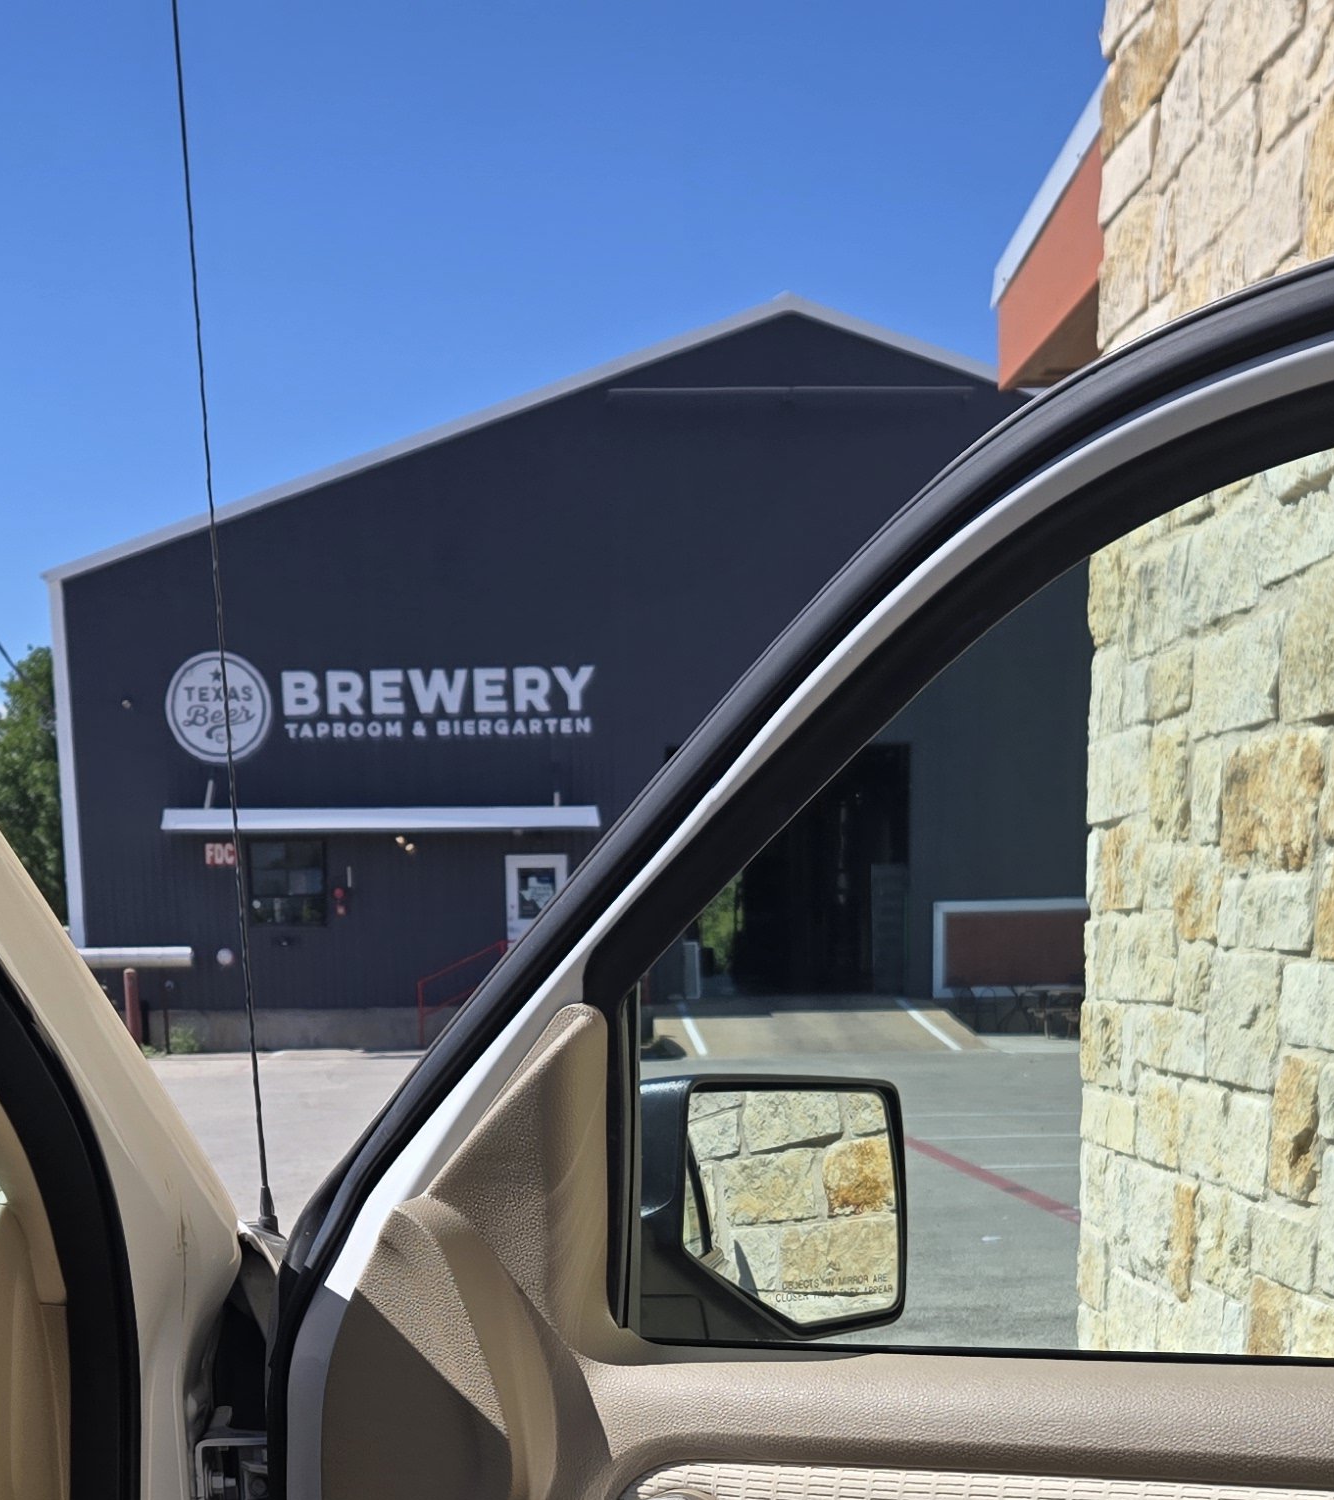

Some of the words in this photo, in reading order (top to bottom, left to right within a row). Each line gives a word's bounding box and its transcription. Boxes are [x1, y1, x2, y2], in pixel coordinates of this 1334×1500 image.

[183, 686, 253, 702] TEXAS
[281, 664, 595, 716] BREWERY
[182, 704, 256, 728] Beer
[284, 720, 403, 739] TAPROOM
[412, 719, 427, 737] &
[436, 716, 592, 737] BIERGARTEN
[204, 843, 235, 865] FDC
[782, 1278, 820, 1291] OBJECTS
[838, 1275, 869, 1286] MIRROR
[872, 1273, 888, 1284] ARE
